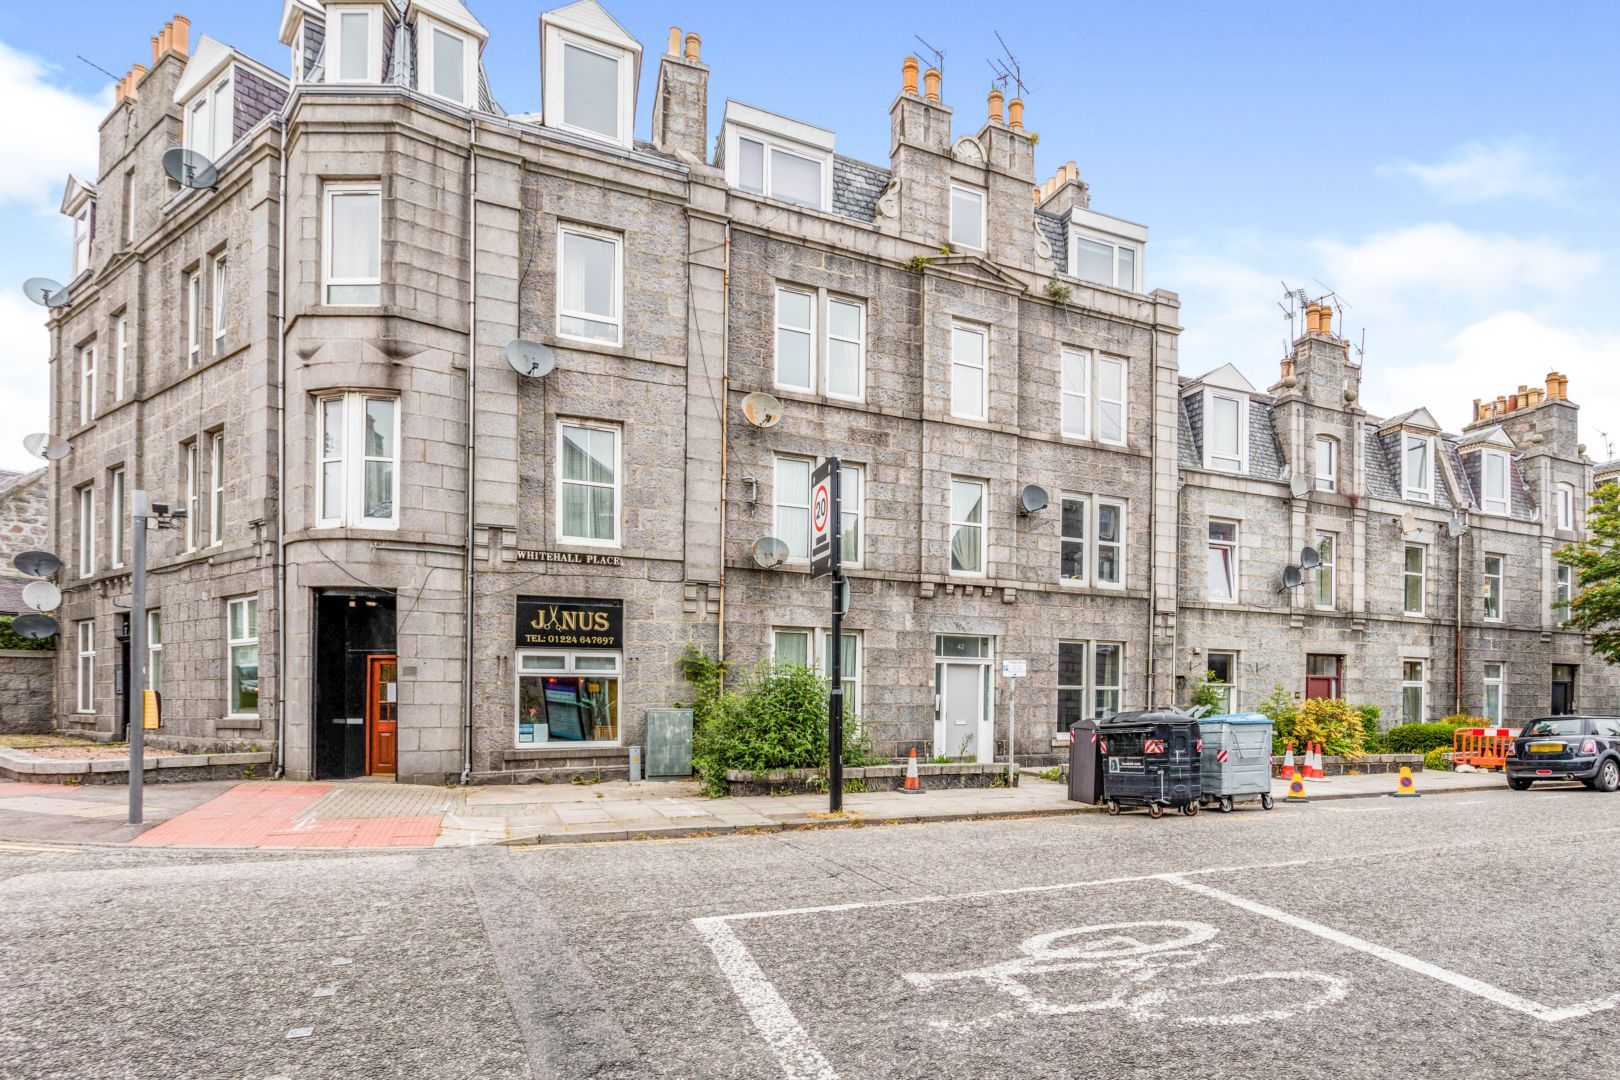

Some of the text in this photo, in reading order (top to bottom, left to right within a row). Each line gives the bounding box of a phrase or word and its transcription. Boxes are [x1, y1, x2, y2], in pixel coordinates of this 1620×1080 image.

[816, 497, 826, 520] 20
[517, 550, 620, 565] WHITEHALL PLACE
[525, 634, 614, 645] TEL: 01224 647697
